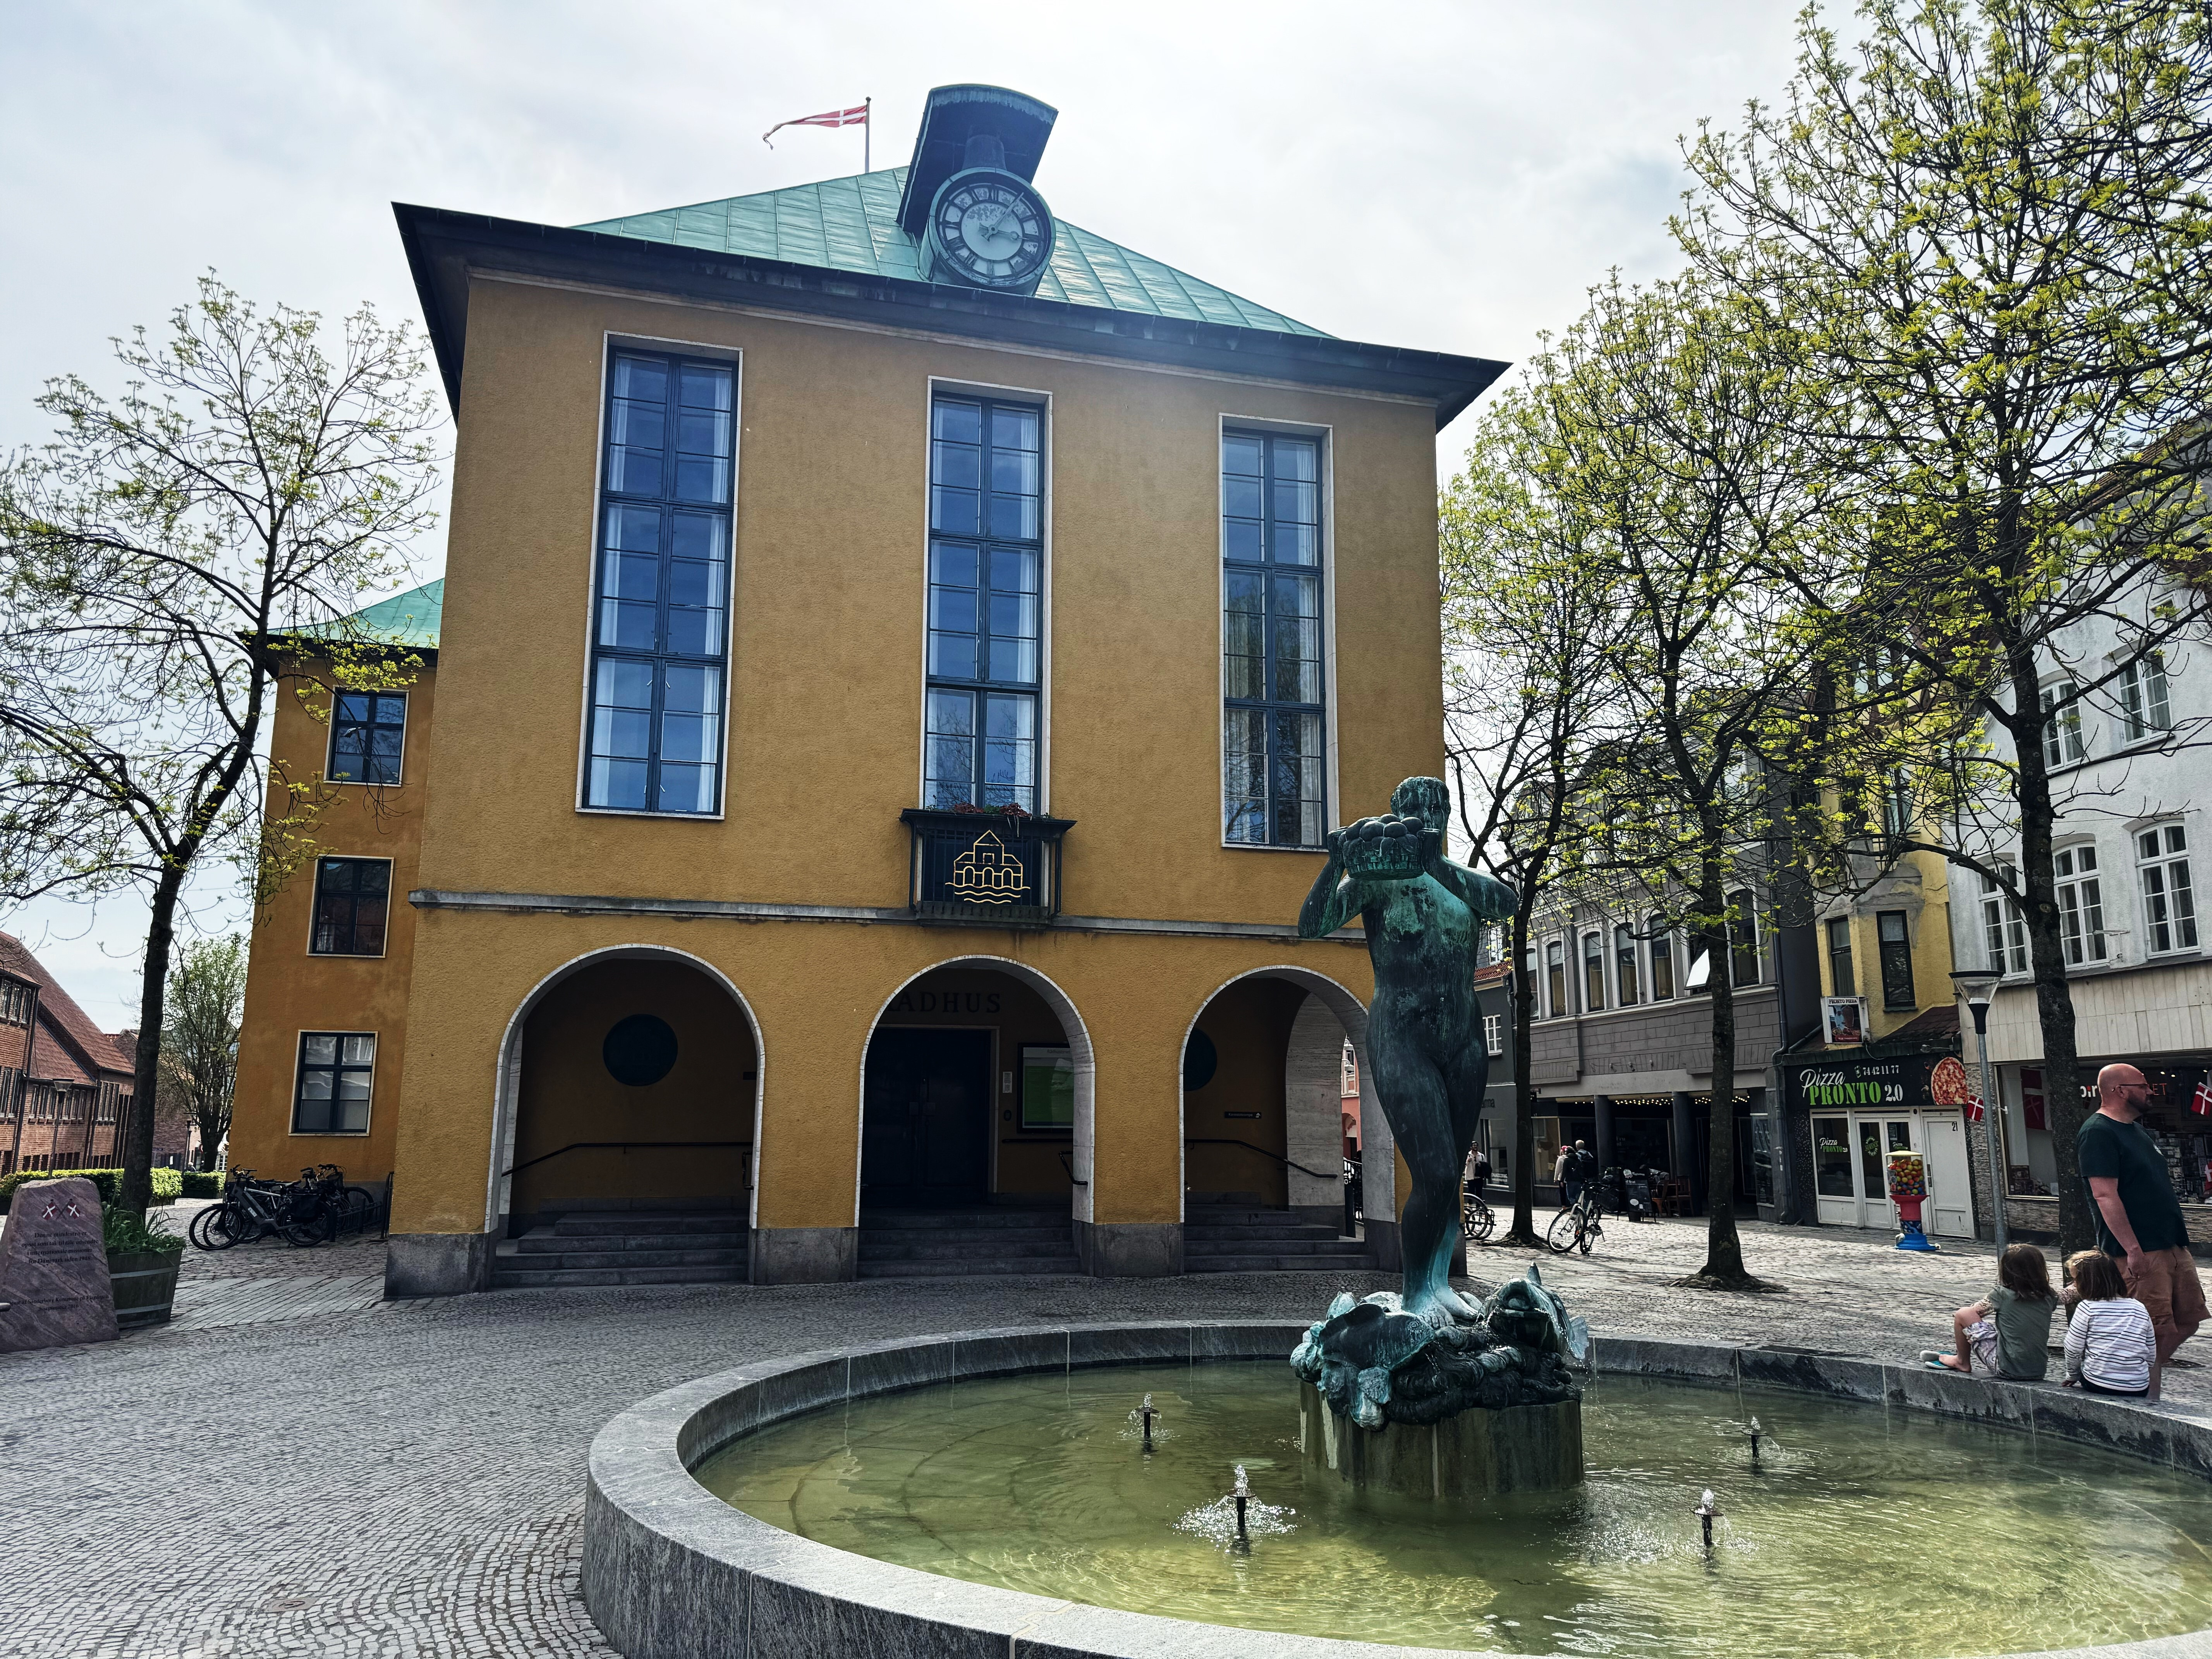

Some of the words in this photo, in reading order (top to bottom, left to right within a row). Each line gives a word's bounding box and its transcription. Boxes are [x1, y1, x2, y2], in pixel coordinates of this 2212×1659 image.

[1863, 1067, 1870, 1075] 74
[1872, 1066, 1879, 1075] 42
[1881, 1066, 1889, 1074] 11
[1891, 1065, 1899, 1073] 77
[1800, 1067, 1846, 1097] Pizza
[1810, 1082, 1881, 1105] PRONTO
[1884, 1084, 1903, 1101] 2.0
[1952, 1121, 1958, 1131] 21
[1819, 1137, 1838, 1149] Pizza
